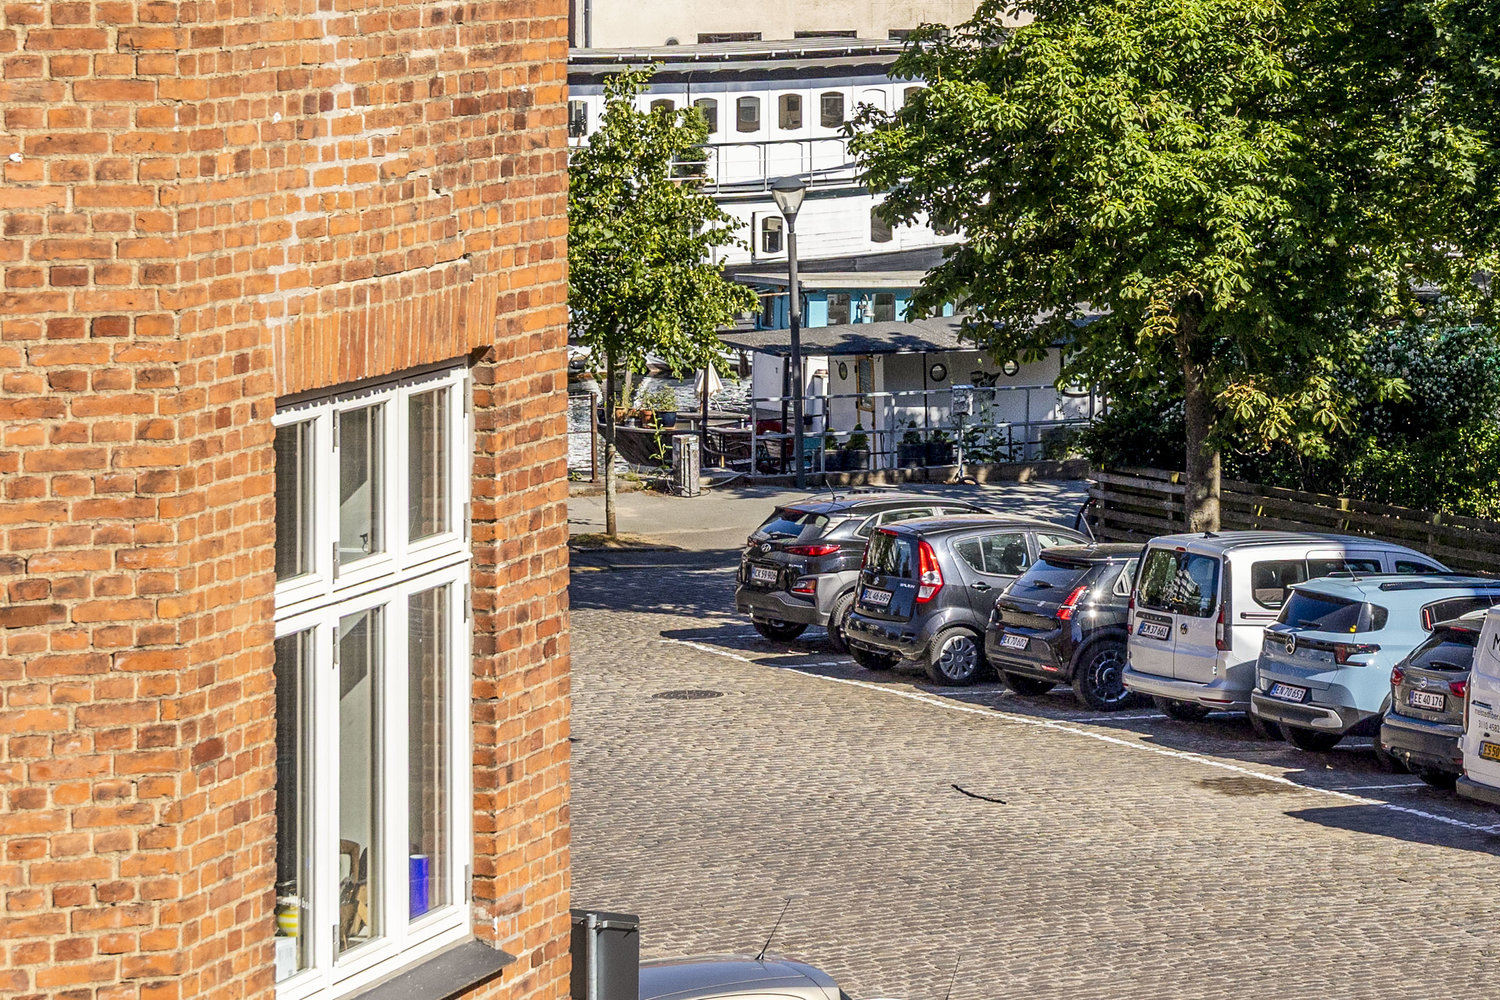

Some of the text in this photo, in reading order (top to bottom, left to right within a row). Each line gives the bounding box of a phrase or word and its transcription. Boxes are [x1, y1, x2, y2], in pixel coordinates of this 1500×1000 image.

[1276, 686, 1304, 699] EN 70 653
[1414, 693, 1443, 707] EE 40 176
